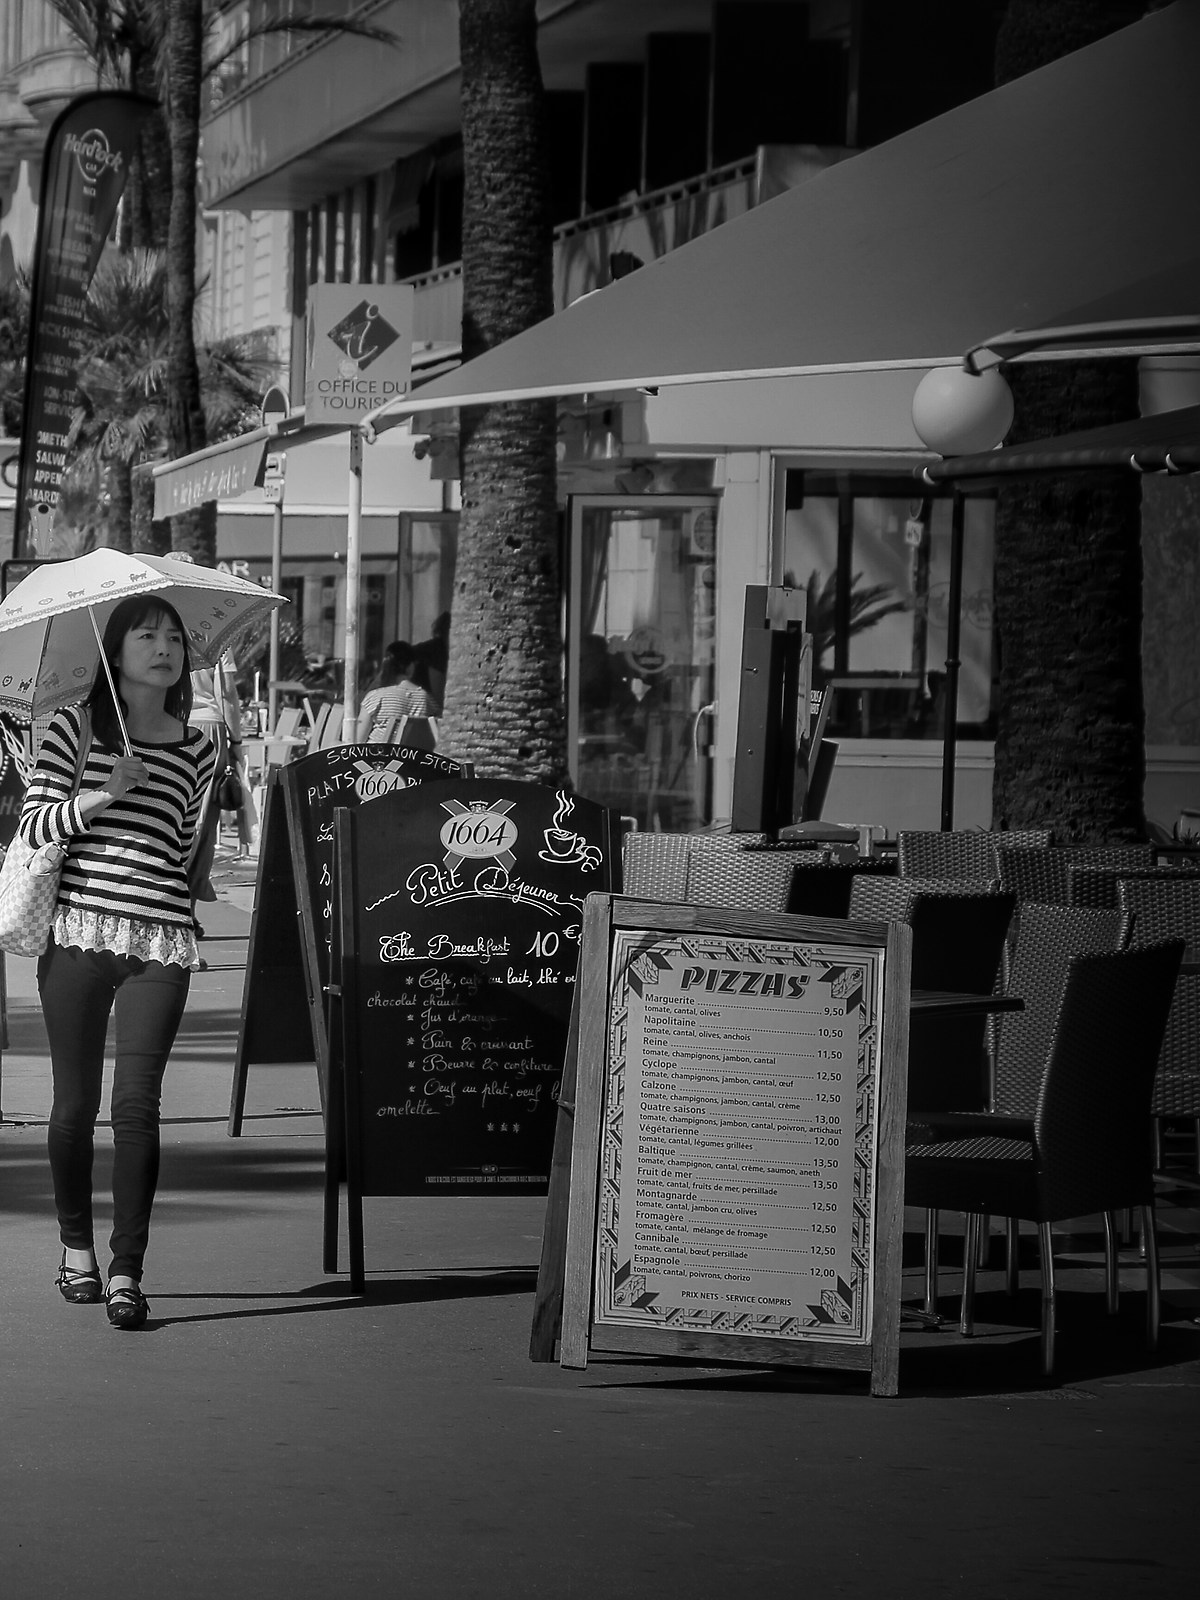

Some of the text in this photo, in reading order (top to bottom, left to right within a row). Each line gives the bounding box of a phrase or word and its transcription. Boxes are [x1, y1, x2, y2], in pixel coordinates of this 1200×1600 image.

[318, 379, 407, 394] OFFICE DU
[320, 396, 389, 409] TOURIS
[217, 560, 250, 576] AR
[390, 747, 418, 760] NON
[420, 753, 460, 774] STOP
[308, 771, 355, 805] PLATS
[448, 816, 511, 847] 1664
[406, 864, 563, 904] Petit Déjeuner
[379, 931, 415, 962] The
[428, 935, 511, 963] Breakfast
[507, 967, 533, 987] lait,
[537, 967, 561, 984] thé
[680, 966, 811, 999] PIZZAS
[367, 990, 417, 1008] chocolat
[644, 1004, 721, 1016] tomate, cantal, olives
[645, 993, 844, 1017] Marguerite 9,50
[421, 1007, 442, 1030] Jus
[644, 1015, 843, 1038] Napolitaine 10,50
[422, 1030, 453, 1050] Pain
[481, 1035, 534, 1050] croissant
[643, 1026, 750, 1041] tomate, cantal, olives, anchois
[642, 1048, 776, 1064] tomate, champignons, jambon, cantal
[643, 1037, 842, 1059] Reine 11,50
[423, 1054, 475, 1072] Beurre
[504, 1057, 558, 1080] confiture
[642, 1059, 841, 1081] Cyclope 12,50
[641, 1070, 669, 1080] tomate,
[671, 1072, 720, 1083] champignons,
[721, 1075, 751, 1085] jambon,
[753, 1078, 777, 1087] cantal,
[424, 1078, 456, 1107] Oeuf
[462, 1085, 477, 1094] au
[482, 1081, 514, 1108] plat,
[516, 1084, 542, 1112] oeuf
[640, 1091, 668, 1101] tomate,
[670, 1094, 719, 1105] champignons,
[720, 1097, 750, 1107] jambon,
[752, 1100, 776, 1109] cantal,
[641, 1080, 841, 1103] Calzone 12,50
[376, 1099, 439, 1116] omelette
[640, 1102, 840, 1125] Quatre saisons 13,00
[639, 1113, 842, 1134] tomate, champignons, jambon, cantal, poivron, artichaut
[638, 1134, 666, 1144] tomate,
[668, 1137, 692, 1146] cantal,
[694, 1138, 724, 1148] légumes
[639, 1124, 839, 1146] Végétarienne 12,00
[638, 1145, 838, 1168] Baltique 13,50
[638, 1156, 665, 1166] tomate,
[667, 1159, 713, 1170] champignon,
[715, 1163, 739, 1172] cantal,
[767, 1167, 797, 1176] saumon,
[637, 1167, 658, 1176] Fruit
[661, 1169, 673, 1177] de
[813, 1181, 838, 1190] 13,50
[637, 1178, 664, 1188] tomate,
[666, 1181, 690, 1190] cantal,
[692, 1182, 712, 1190] fruits
[724, 1186, 740, 1194] mer,
[742, 1187, 778, 1195] persillade
[636, 1189, 837, 1212] Montagnarde 12,50
[636, 1200, 757, 1215] tomate, cantal, jambon cru, olives
[635, 1210, 836, 1233] Fromagère 12,50
[635, 1222, 663, 1232] tomate,
[665, 1225, 689, 1234] cantal,
[726, 1228, 735, 1236] de
[737, 1229, 768, 1240] fromage
[634, 1244, 662, 1254] tomate,
[663, 1247, 688, 1256] cantal,
[712, 1250, 748, 1259] persillade
[635, 1232, 835, 1256] Cannibale 12,50
[633, 1266, 751, 1281] tomate, cantal, poivrons, chorizo
[634, 1254, 835, 1278] Espagnole 12,00
[681, 1291, 698, 1300] PRIX
[700, 1292, 719, 1301] NETS
[725, 1294, 756, 1304] SERVICE
[757, 1296, 792, 1306] COMPRIS
